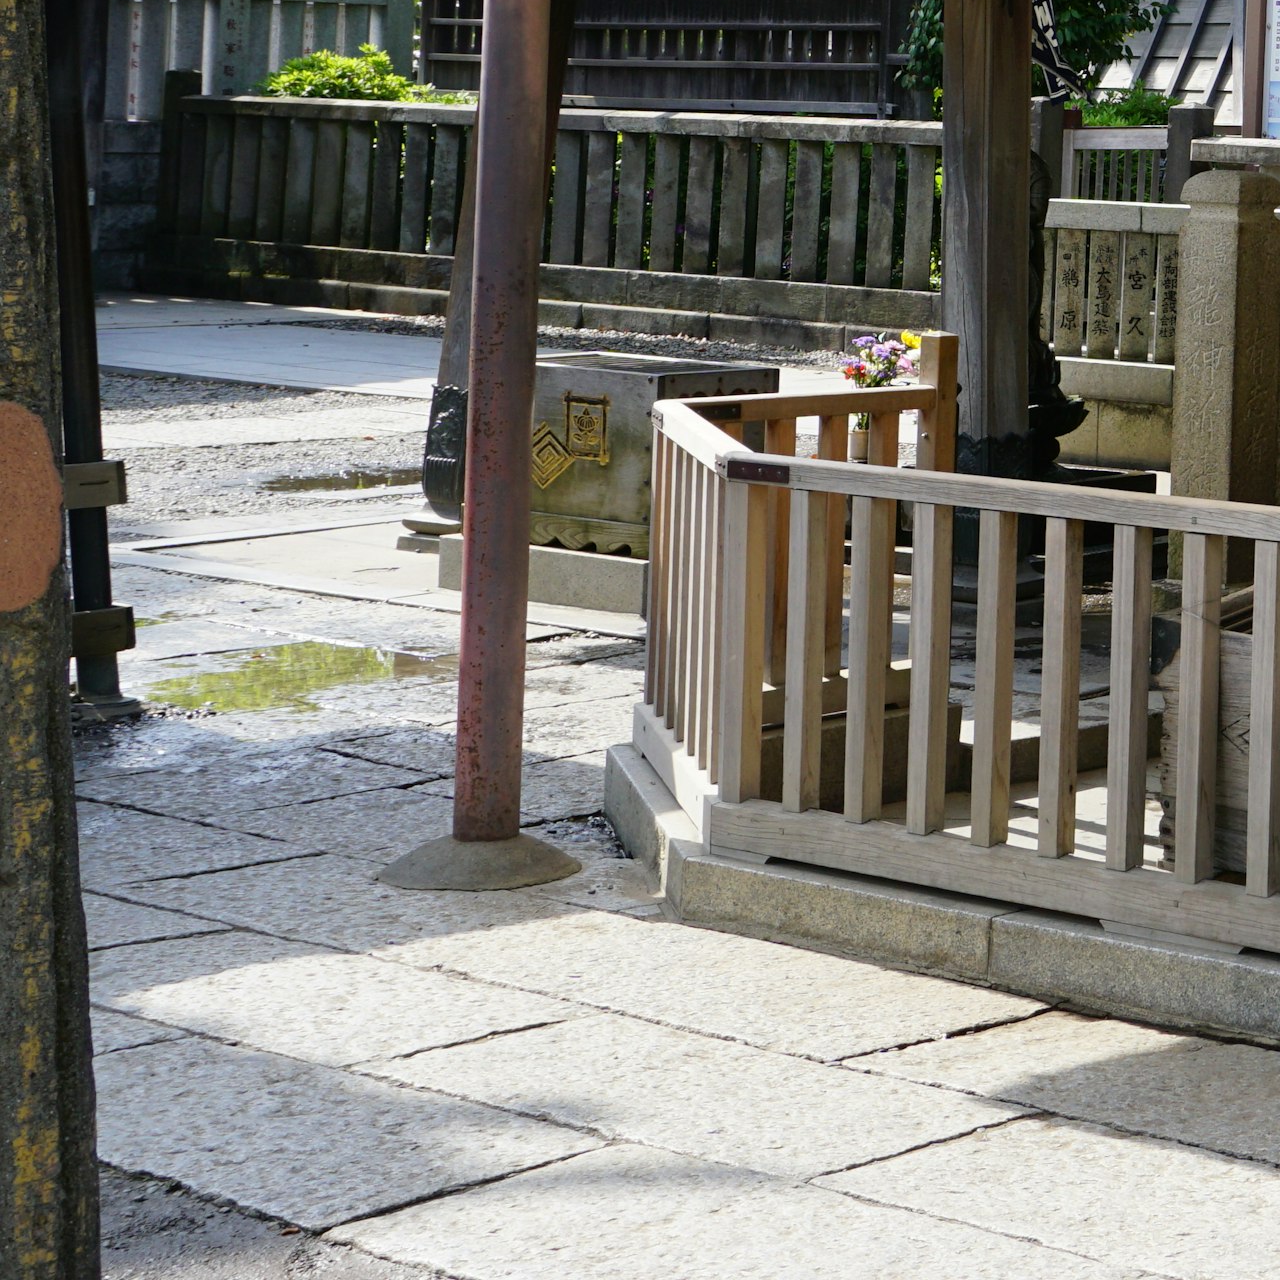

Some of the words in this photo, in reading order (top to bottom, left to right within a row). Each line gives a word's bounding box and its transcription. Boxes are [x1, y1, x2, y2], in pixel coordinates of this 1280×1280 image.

[1092, 266, 1112, 336] 大島建築
[1127, 270, 1147, 336] 宮久
